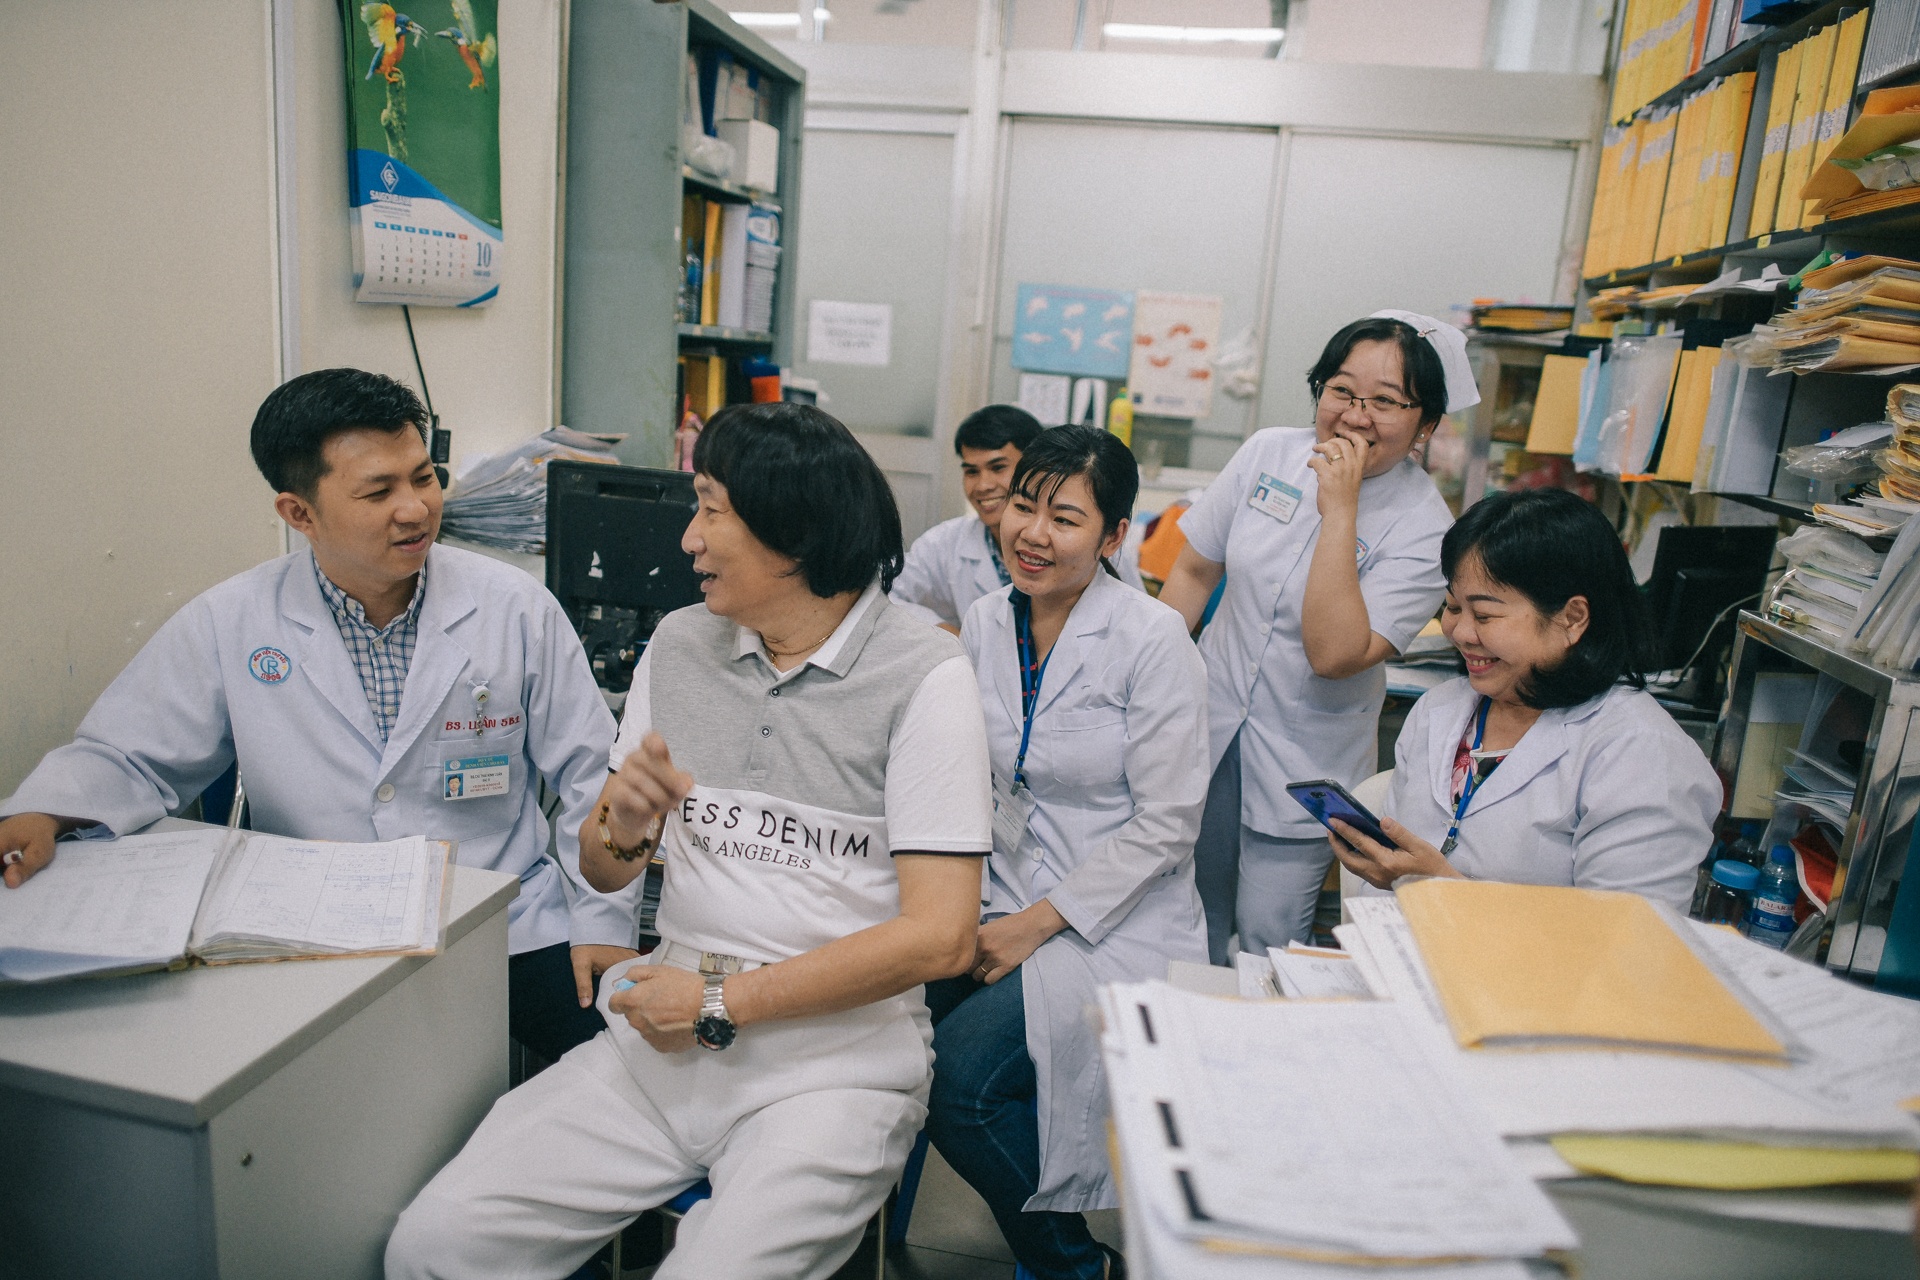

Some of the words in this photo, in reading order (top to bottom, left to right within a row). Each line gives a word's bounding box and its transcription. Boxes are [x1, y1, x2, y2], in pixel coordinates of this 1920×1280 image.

[477, 242, 491, 268] 10
[675, 797, 742, 829] ESS
[757, 810, 869, 857] DENIM
[714, 840, 811, 870] ANGELES
